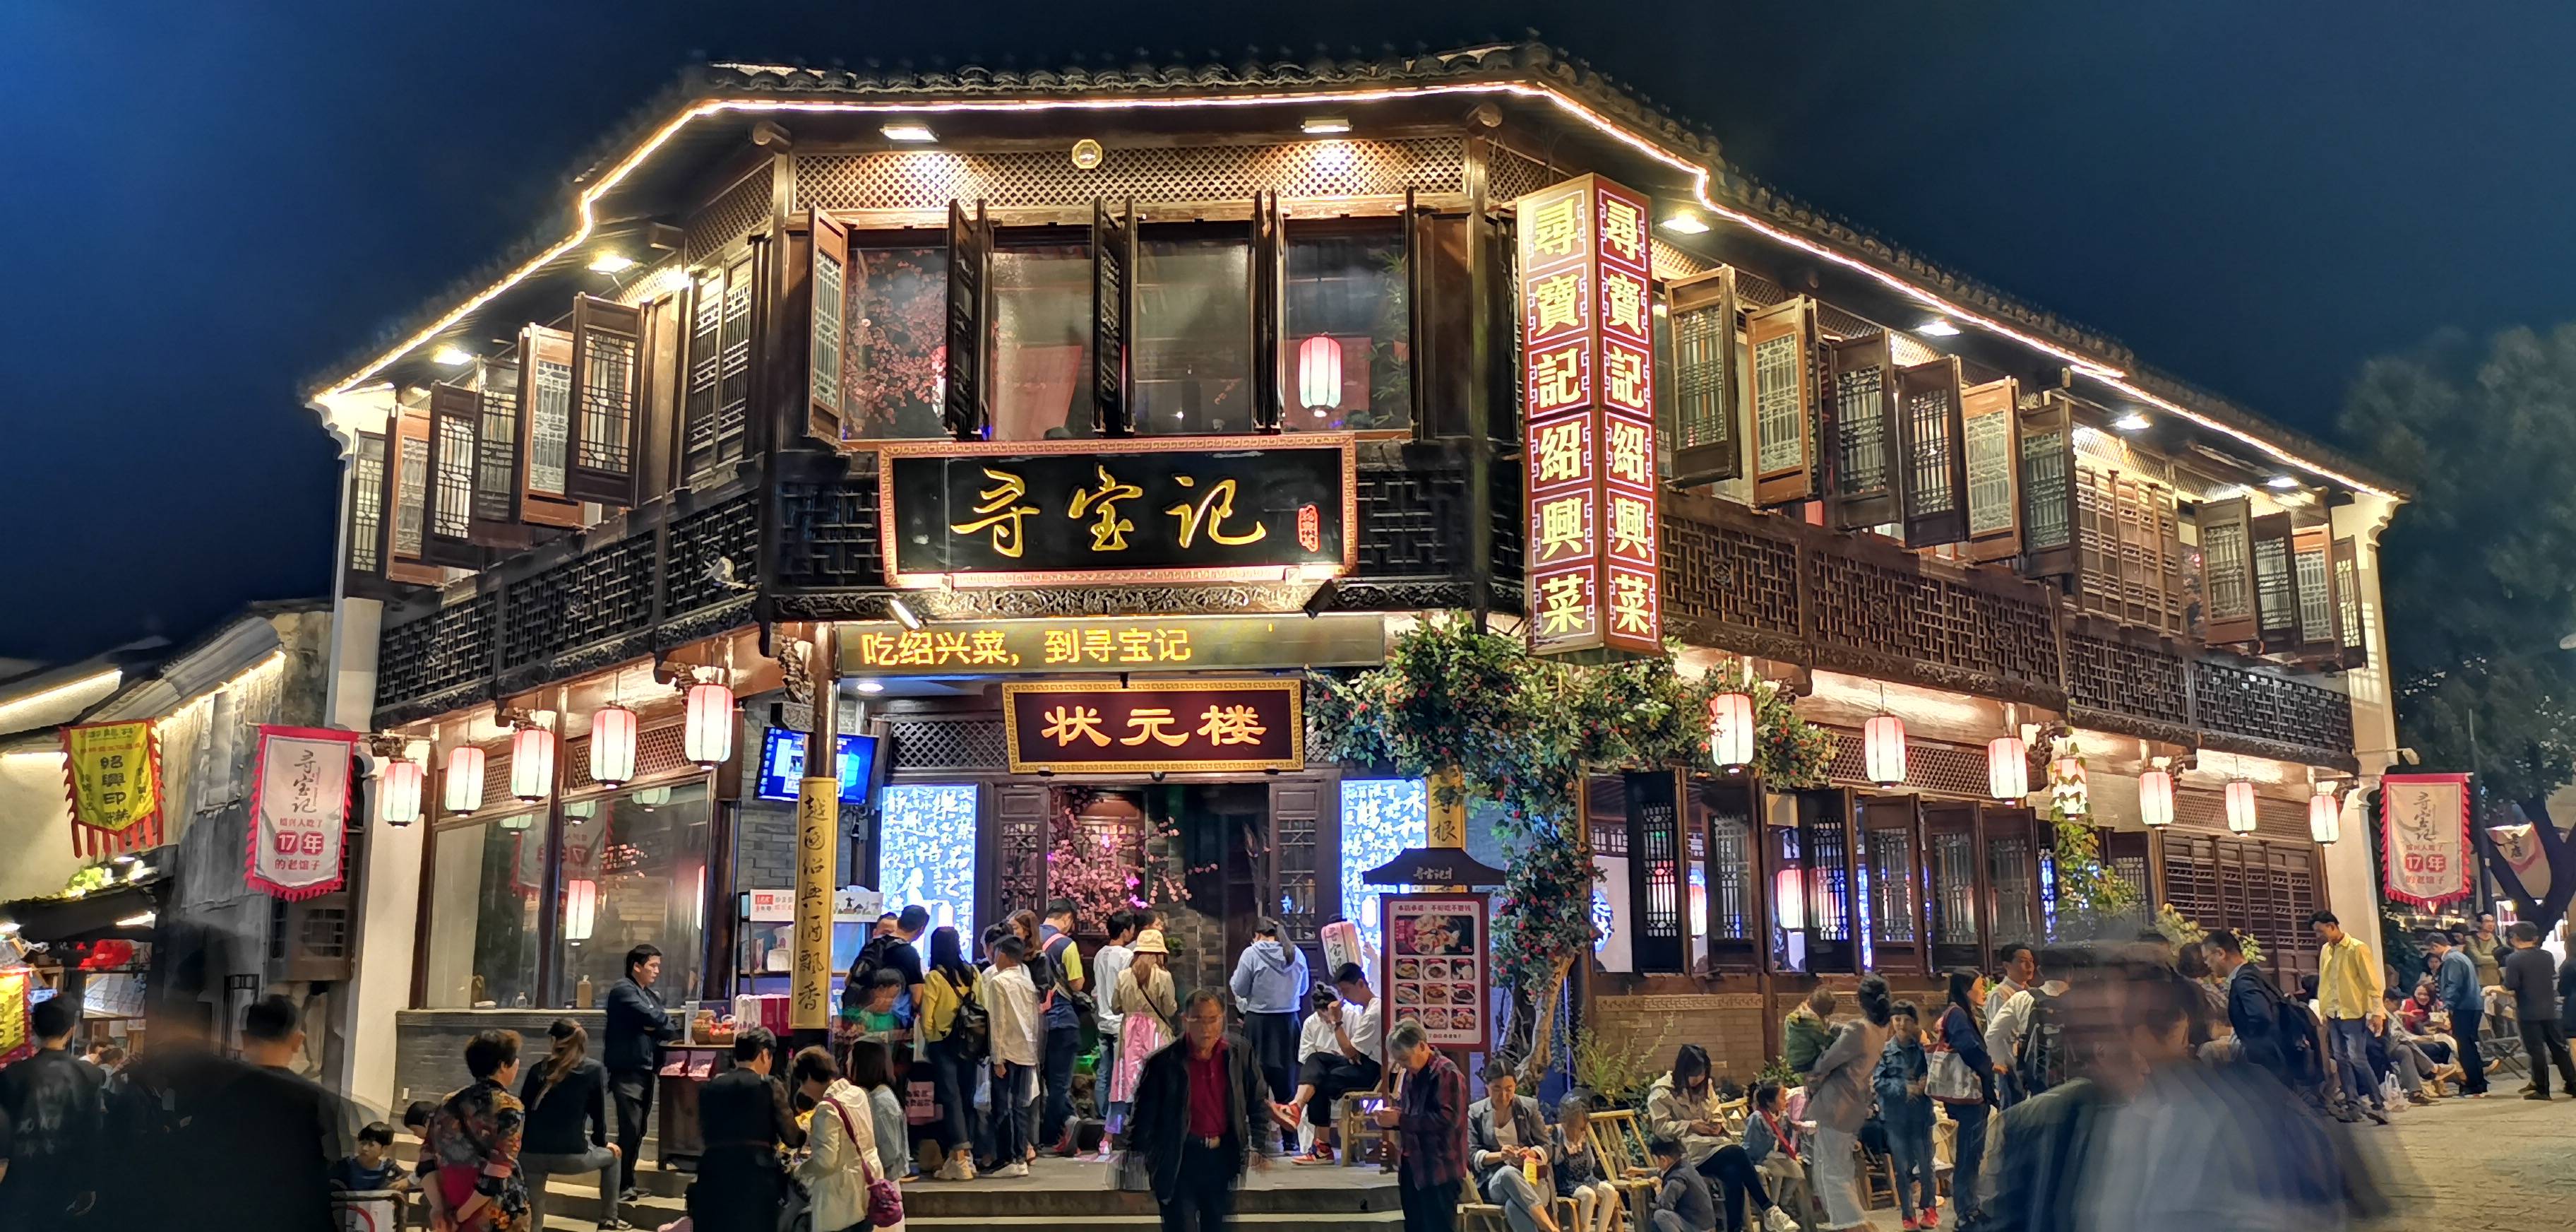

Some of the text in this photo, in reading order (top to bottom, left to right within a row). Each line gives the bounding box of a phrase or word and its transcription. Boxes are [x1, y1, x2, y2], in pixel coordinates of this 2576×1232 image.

[1534, 197, 1587, 636] 尋寶記紹興菜
[1605, 198, 1651, 636] 尋寶記紹興菜
[950, 464, 1267, 557] 寻宝记
[1041, 704, 1268, 747] 状元楼
[292, 749, 317, 813] 寻宝记
[2413, 791, 2437, 841] 寻宝记
